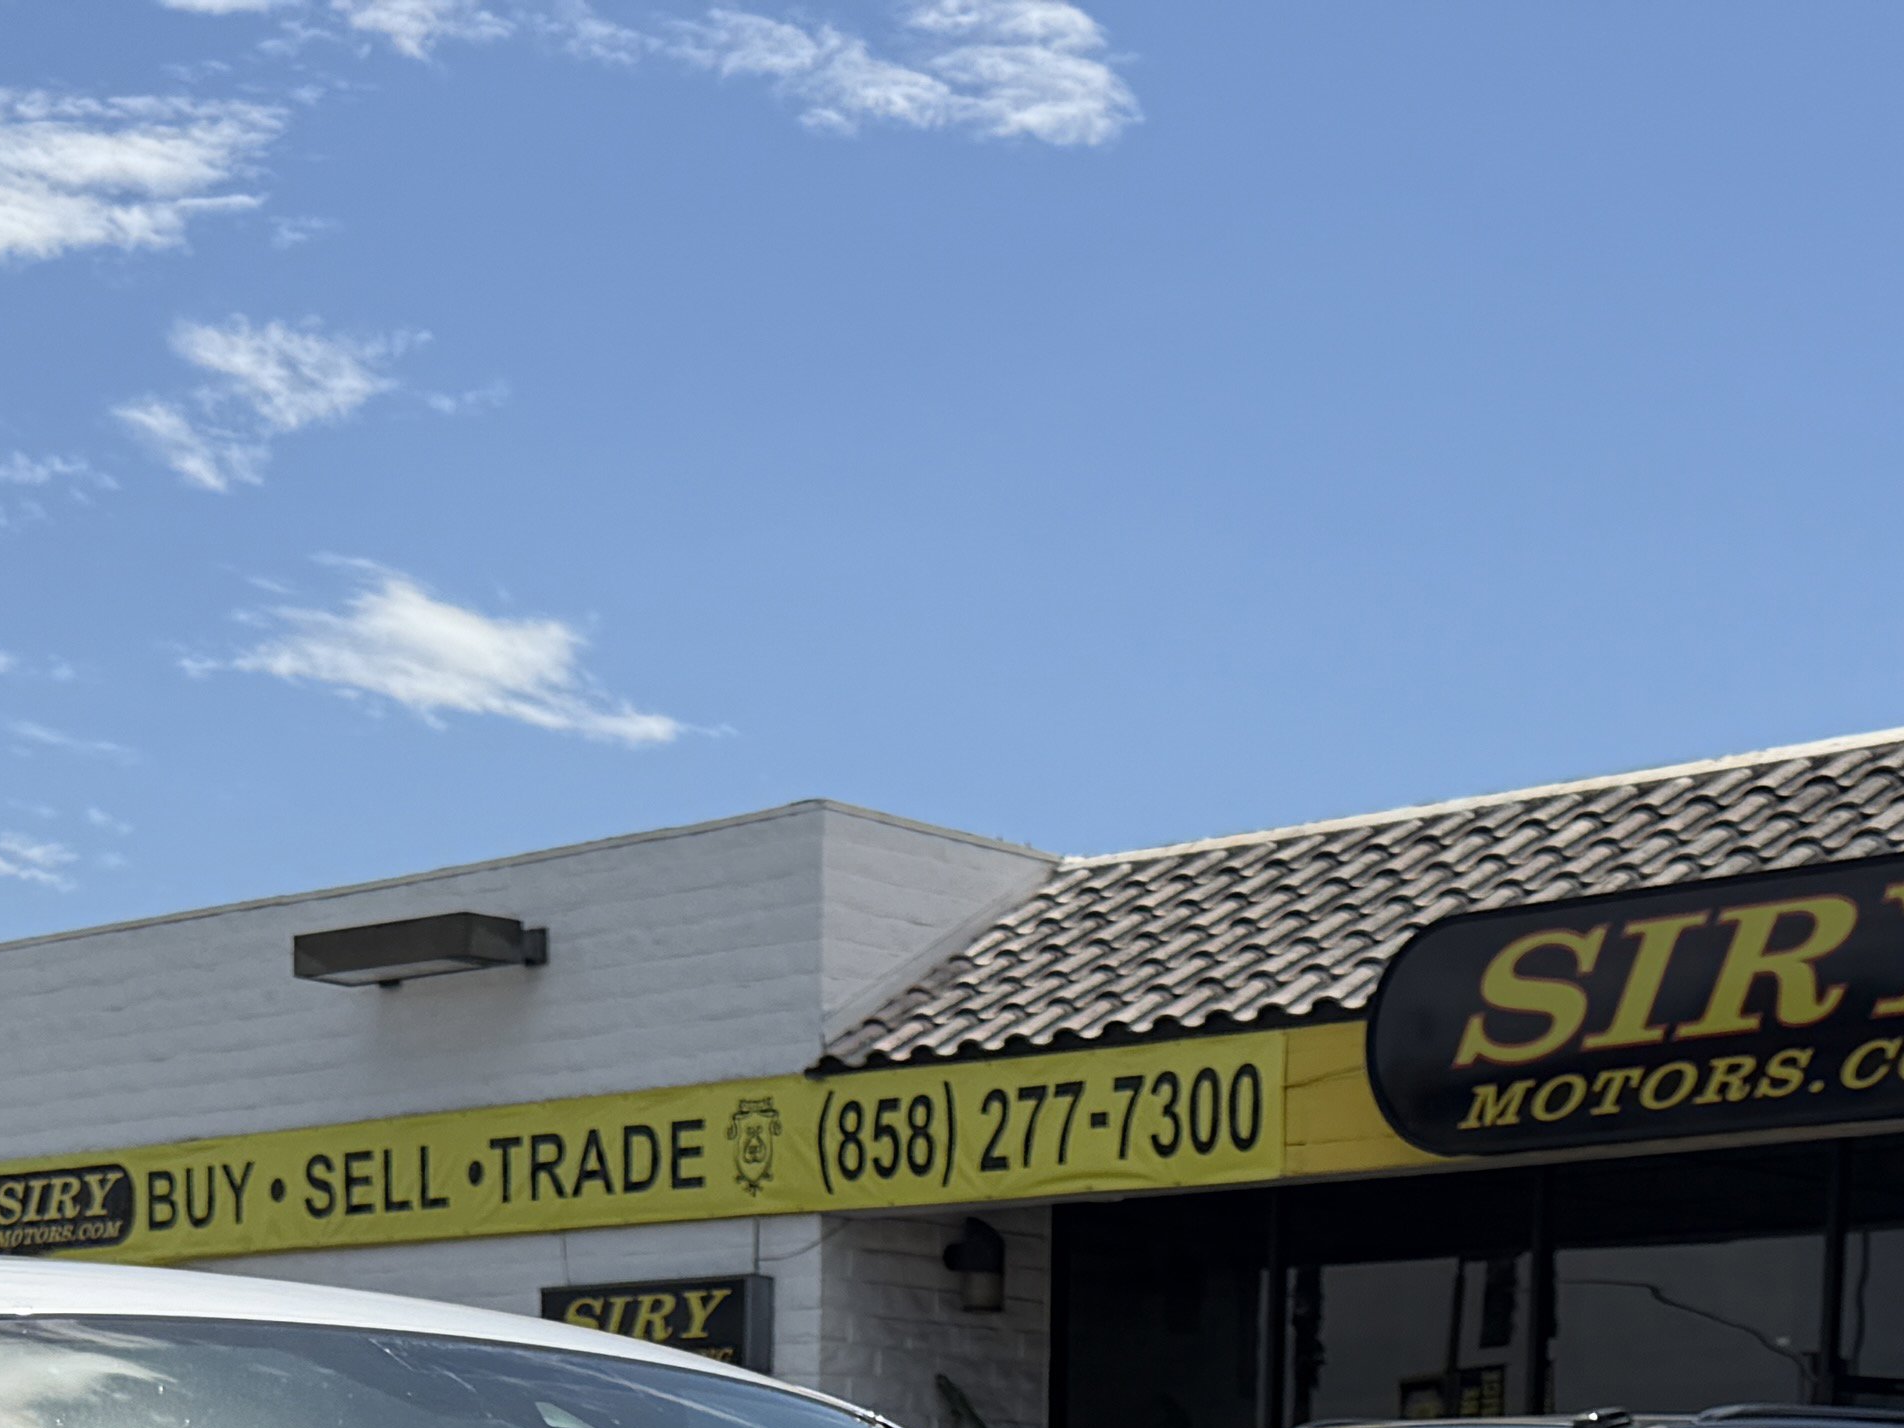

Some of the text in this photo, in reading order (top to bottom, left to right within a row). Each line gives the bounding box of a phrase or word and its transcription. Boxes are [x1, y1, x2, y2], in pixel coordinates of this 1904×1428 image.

[147, 1118, 706, 1232] BUY SELL TRADE
[817, 1063, 1265, 1194] (858) 277-7300
[564, 1289, 733, 1342] SIRY
